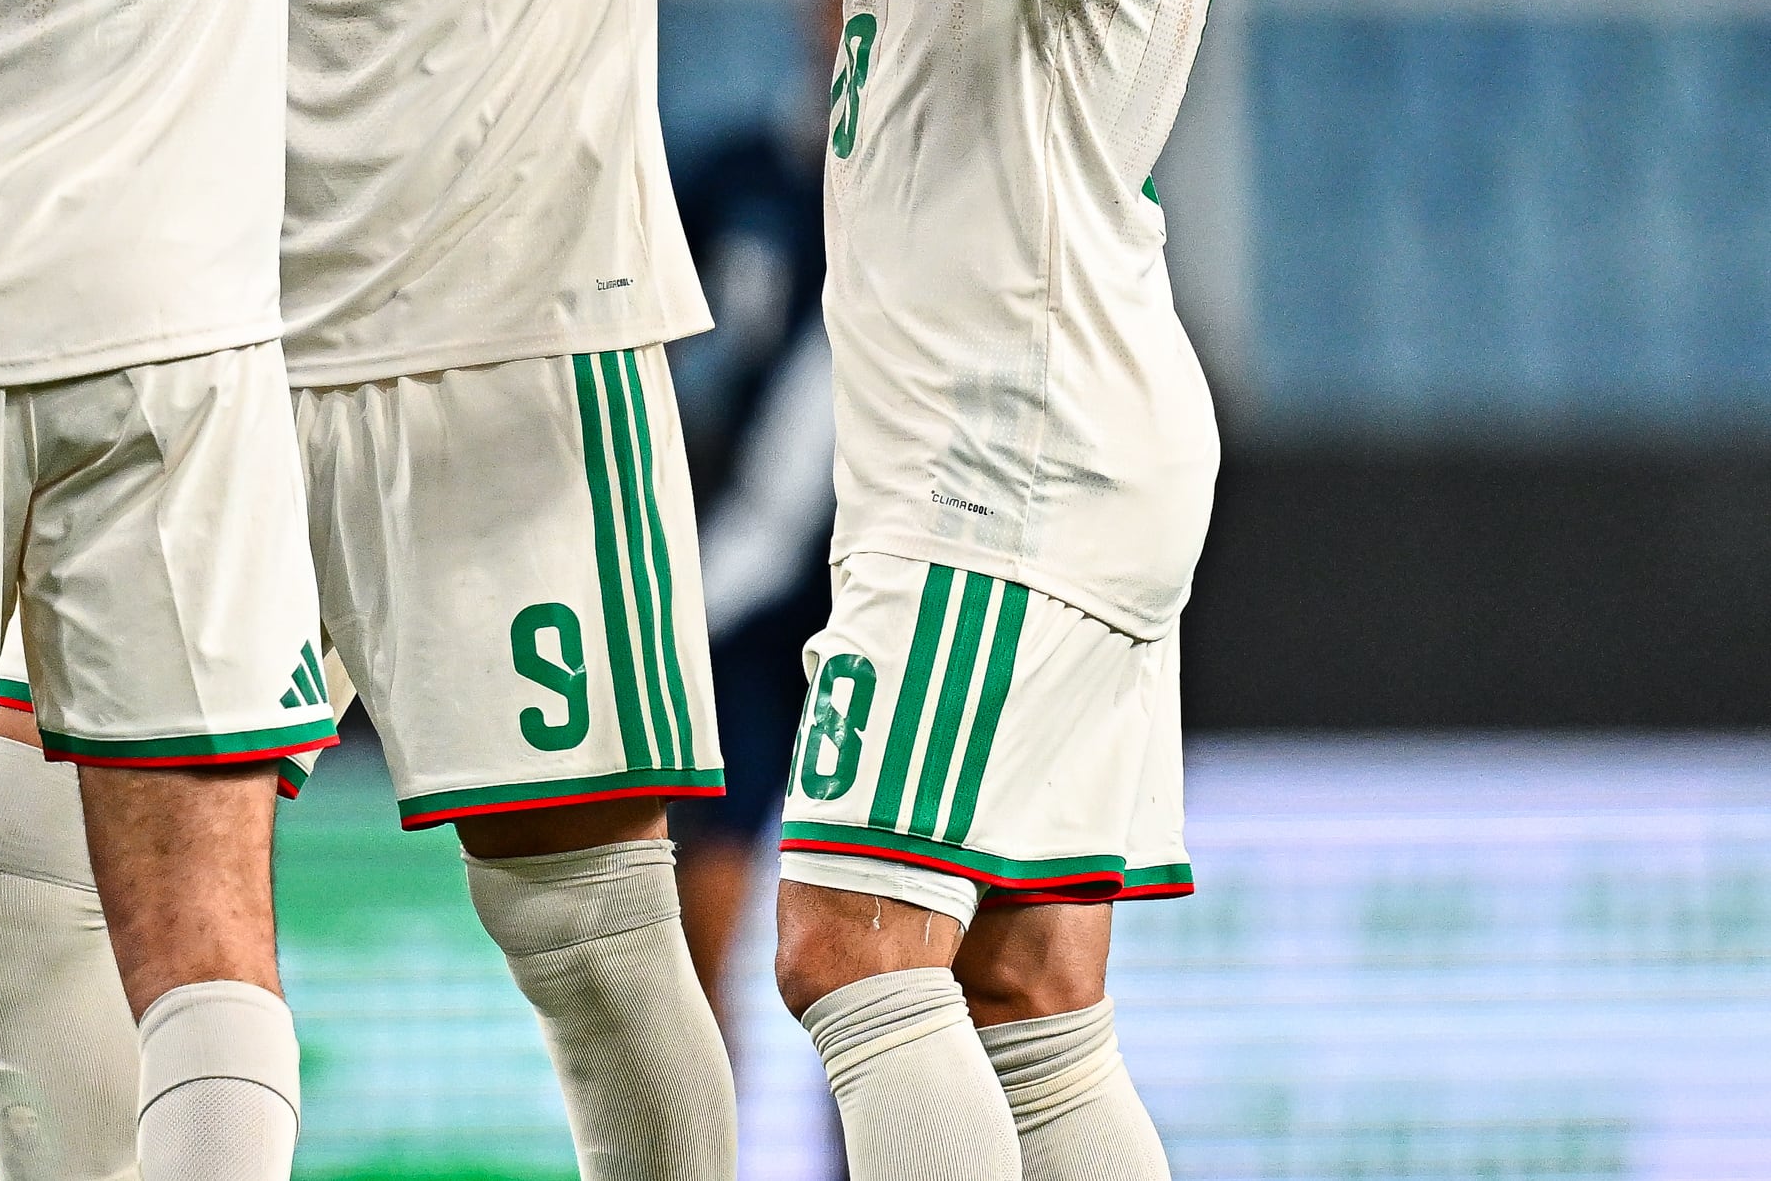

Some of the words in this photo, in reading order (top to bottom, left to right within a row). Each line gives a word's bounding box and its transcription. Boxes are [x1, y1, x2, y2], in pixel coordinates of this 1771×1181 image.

[932, 493, 988, 516] CLIMACOOL
[510, 602, 589, 751] 9
[788, 651, 877, 801] 8
